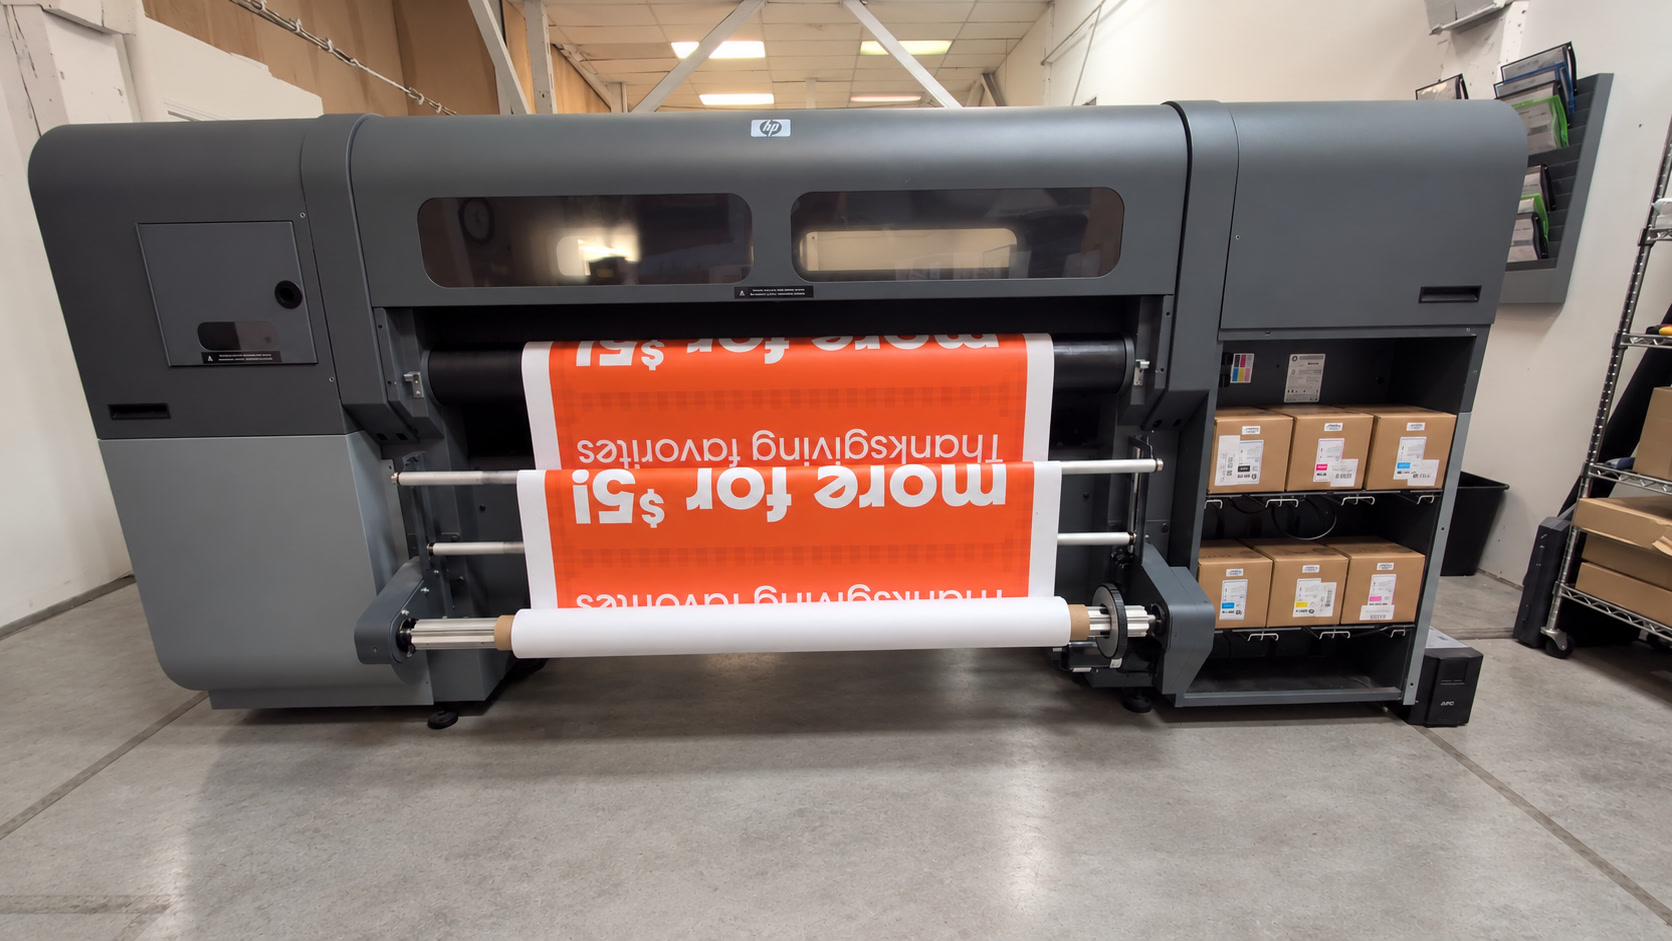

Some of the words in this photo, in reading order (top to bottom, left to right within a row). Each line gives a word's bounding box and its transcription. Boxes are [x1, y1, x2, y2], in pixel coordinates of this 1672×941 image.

[761, 119, 780, 137] hp
[577, 438, 741, 470] favorites
[752, 429, 1004, 467] Thanksgiving
[686, 467, 793, 523] for
[813, 464, 1007, 509] more
